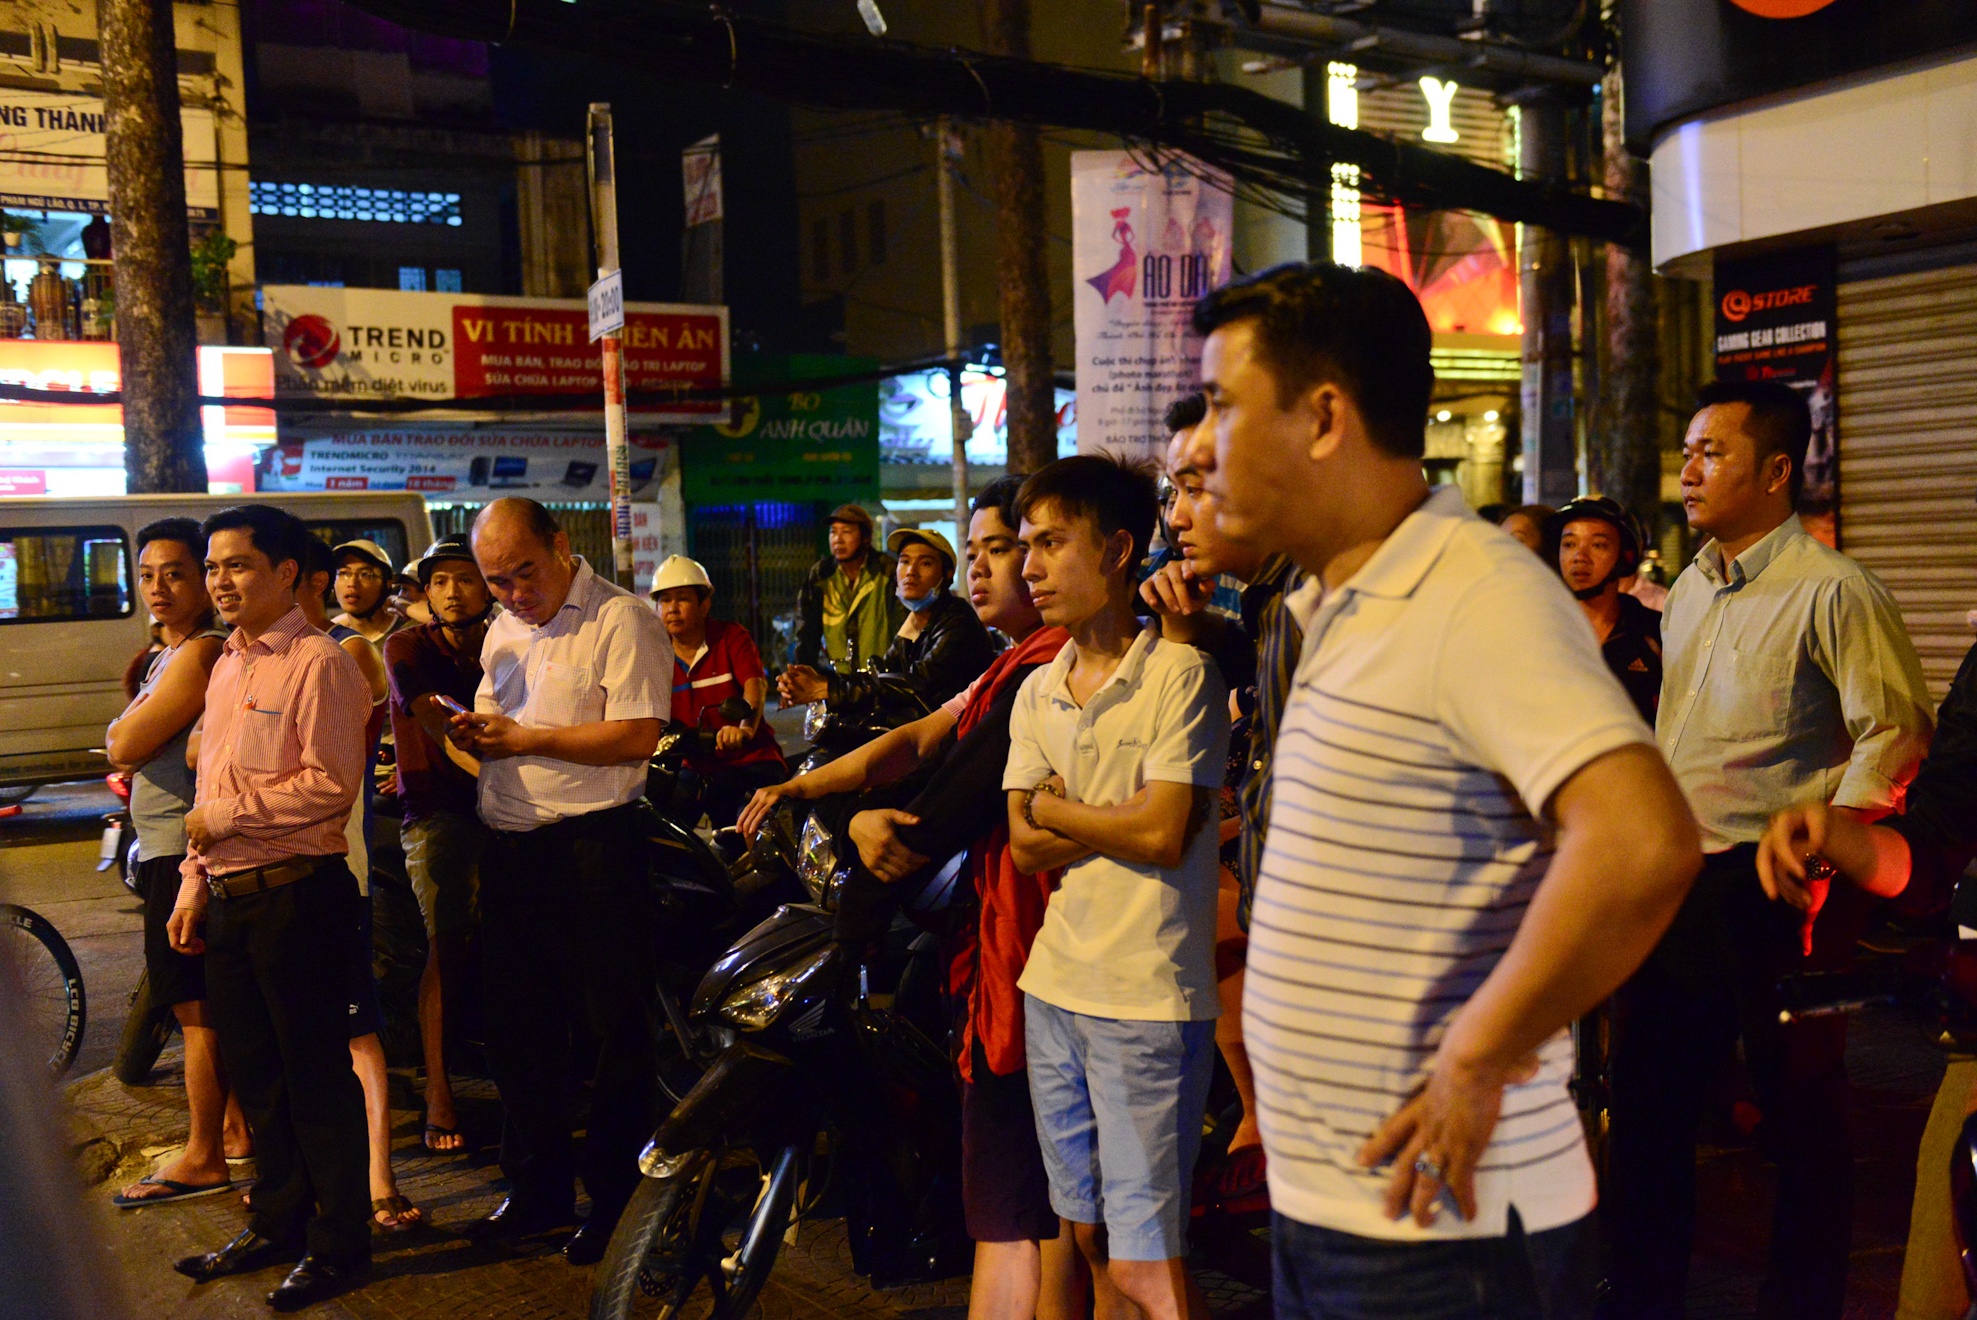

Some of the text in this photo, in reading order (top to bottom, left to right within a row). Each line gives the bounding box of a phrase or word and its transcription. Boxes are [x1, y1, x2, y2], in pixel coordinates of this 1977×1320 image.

[1419, 76, 1460, 143] Y
[348, 326, 445, 349] TREND
[462, 318, 494, 343] VI
[502, 315, 573, 346] TÍNH
[1717, 321, 1827, 353] GAMING GEAR COLLECTION
[350, 350, 443, 365] MICRO
[481, 354, 512, 367] MUA
[549, 356, 582, 370] TRAO
[663, 361, 707, 373] LAPTOP
[408, 377, 447, 393] virus
[551, 374, 598, 388] LAPTOP
[332, 434, 368, 446] MUA
[371, 432, 402, 446] BÁN
[406, 433, 445, 447] TRAO
[310, 464, 436, 475] Internet Security 2014
[68, 978, 80, 1011] LCB
